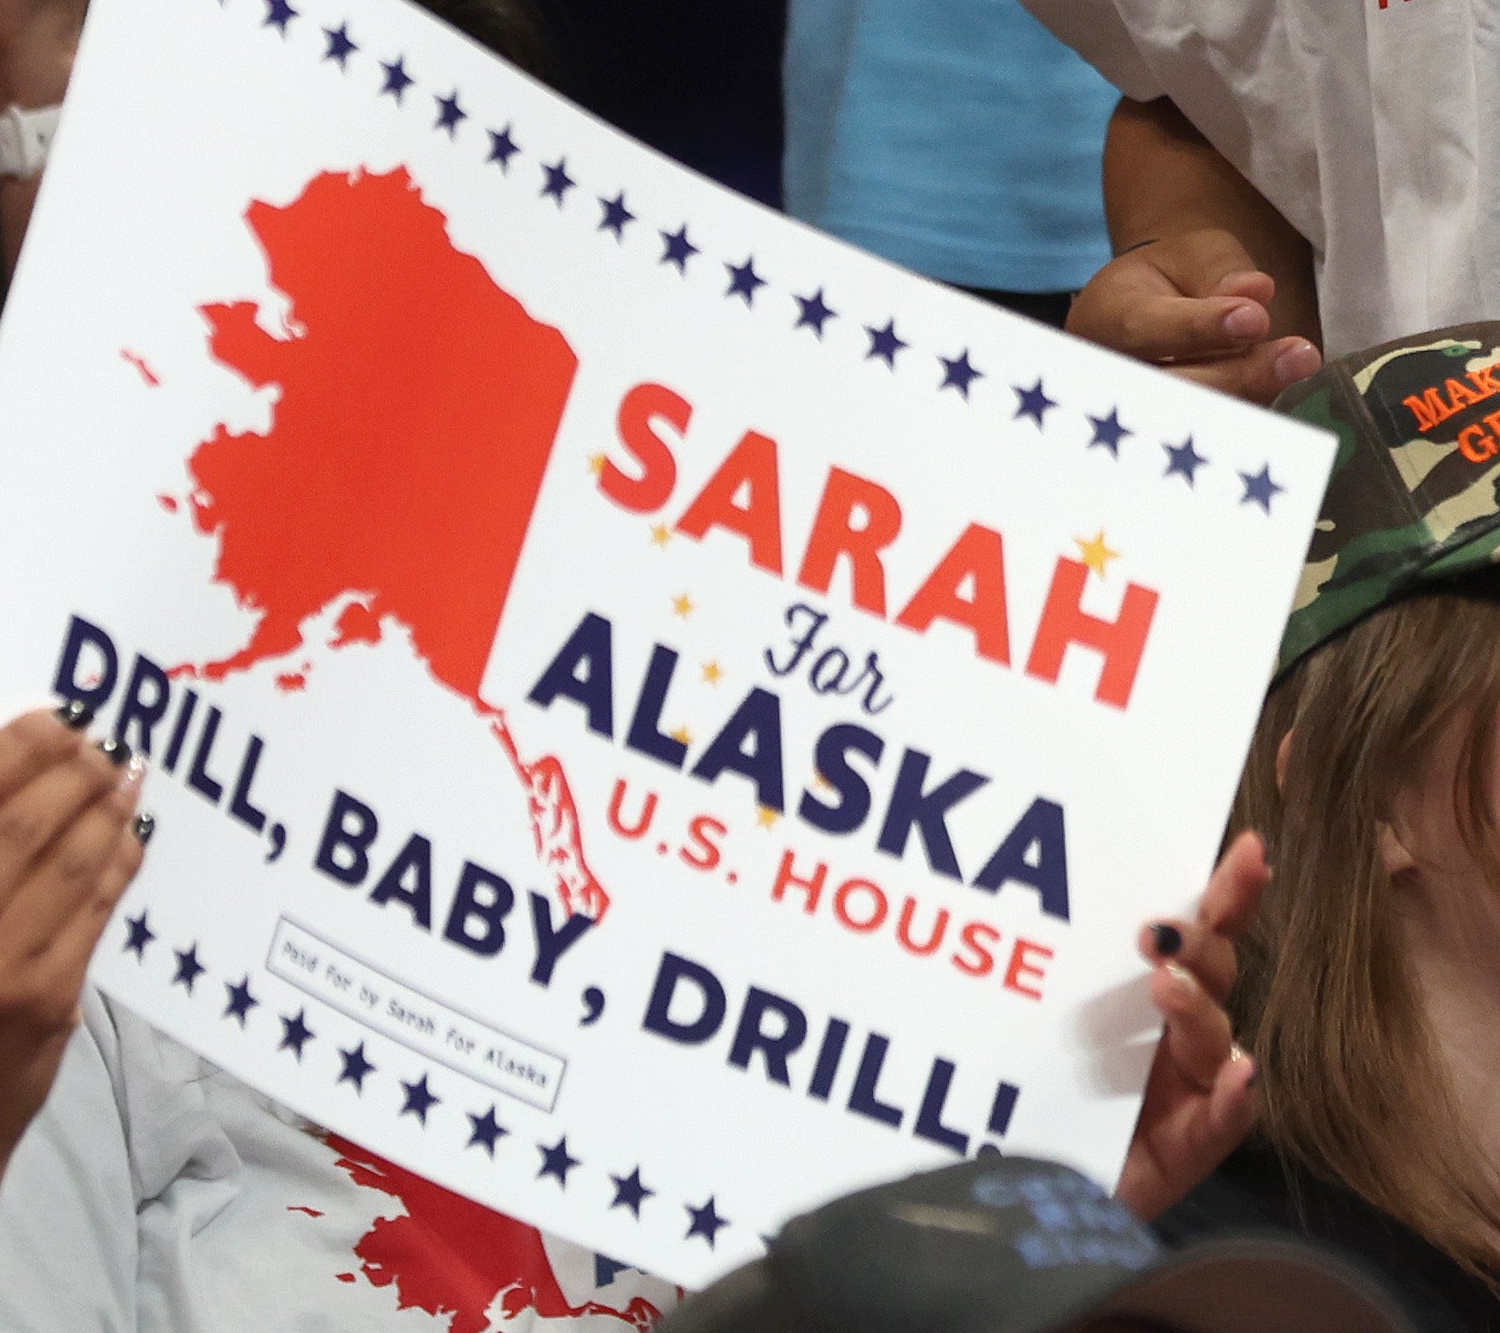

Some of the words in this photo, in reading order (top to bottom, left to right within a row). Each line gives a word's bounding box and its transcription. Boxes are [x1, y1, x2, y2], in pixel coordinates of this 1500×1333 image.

[597, 382, 1160, 712] SARAH
[762, 602, 894, 716] For
[51, 613, 287, 865] DRILL,
[313, 787, 607, 1027] BABY,
[525, 612, 1071, 926] ALASKA
[605, 777, 740, 887] U.S.
[769, 847, 1056, 1002] HOUSE
[387, 997, 436, 1036] Sarah
[486, 1047, 547, 1089] Alaska
